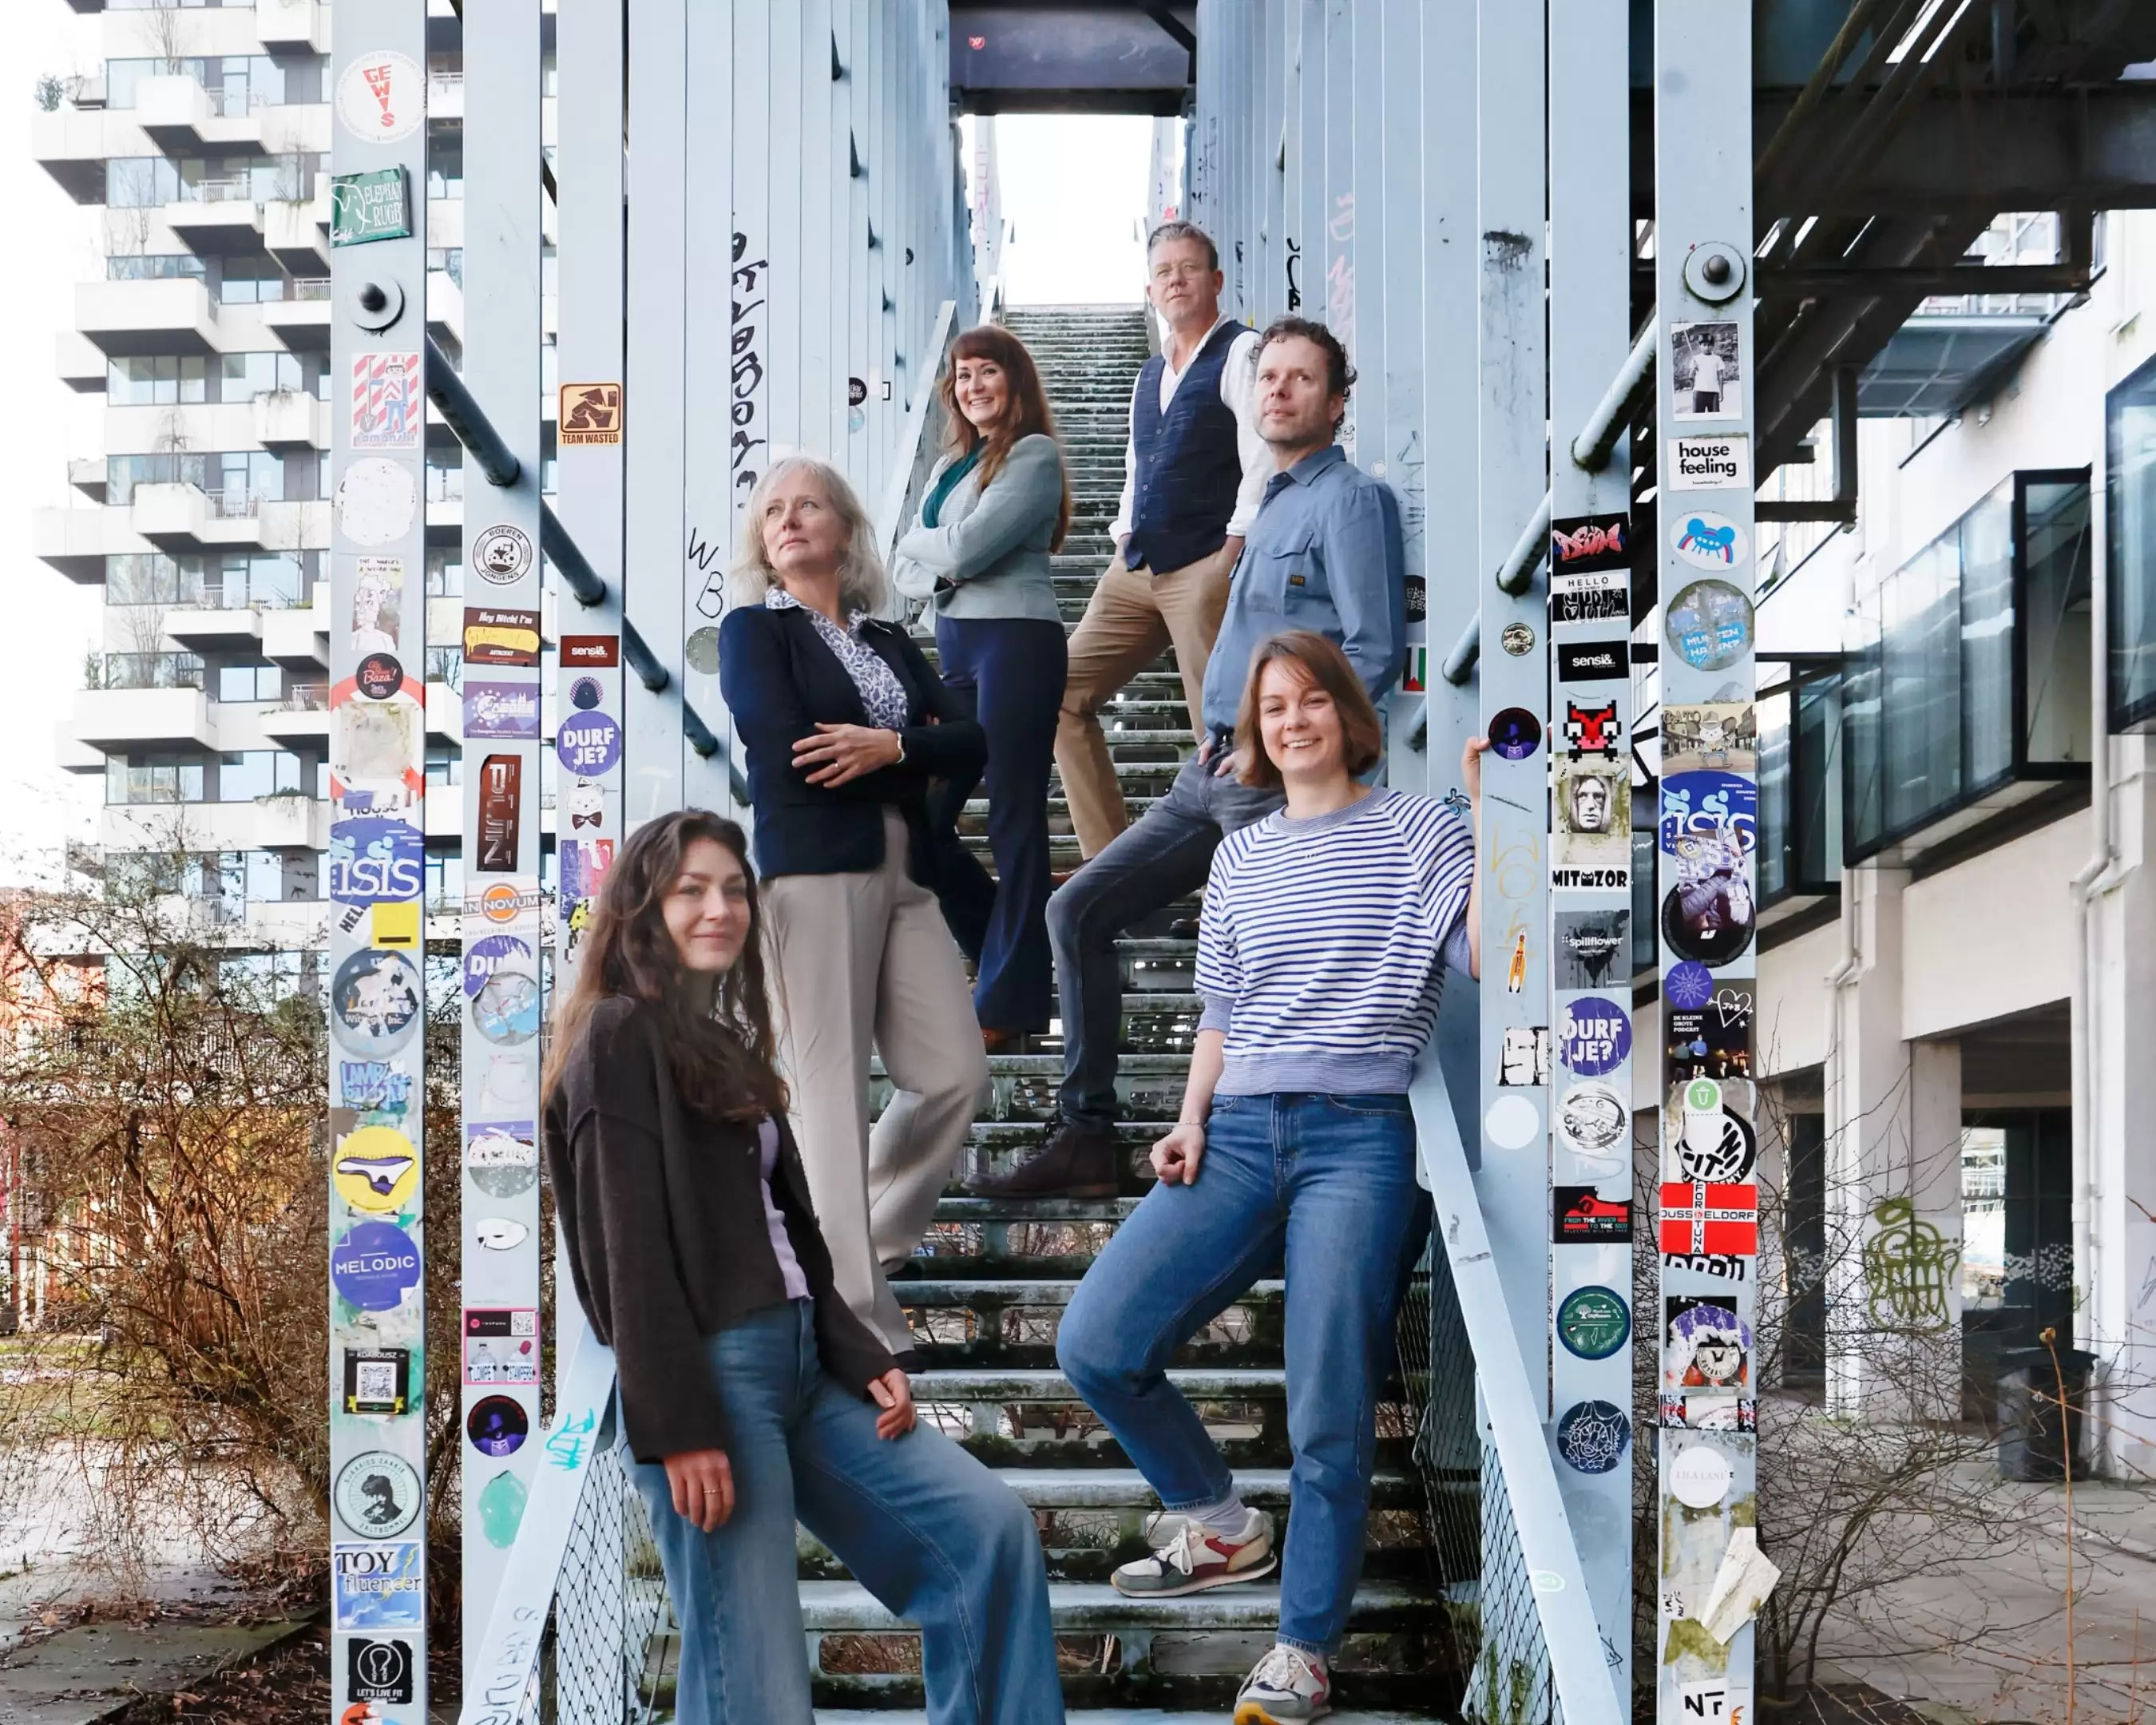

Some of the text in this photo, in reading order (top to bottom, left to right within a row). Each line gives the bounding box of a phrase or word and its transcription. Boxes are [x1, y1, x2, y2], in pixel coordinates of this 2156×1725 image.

[562, 434, 619, 444] TEAM WASTED
[1678, 442, 1730, 458] house
[1679, 458, 1737, 477] feeling
[488, 528, 524, 541] BOEREN
[480, 568, 520, 581] JONGENS
[1568, 577, 1608, 586] HELLO
[478, 612, 495, 624] Hey
[563, 727, 615, 748] DURF
[572, 746, 608, 765] JE?
[338, 859, 420, 897] ISIS
[465, 895, 539, 914] IN NOVUM
[1569, 936, 1624, 948] spillflower
[1563, 1017, 1623, 1041] DURF
[1571, 1040, 1614, 1062] JE?
[335, 1255, 415, 1275] MELODIC
[359, 1517, 408, 1533] ZALTBOMMEL
[335, 1551, 395, 1574] TOY
[357, 1688, 403, 1697] LET'S LIVE FIT
